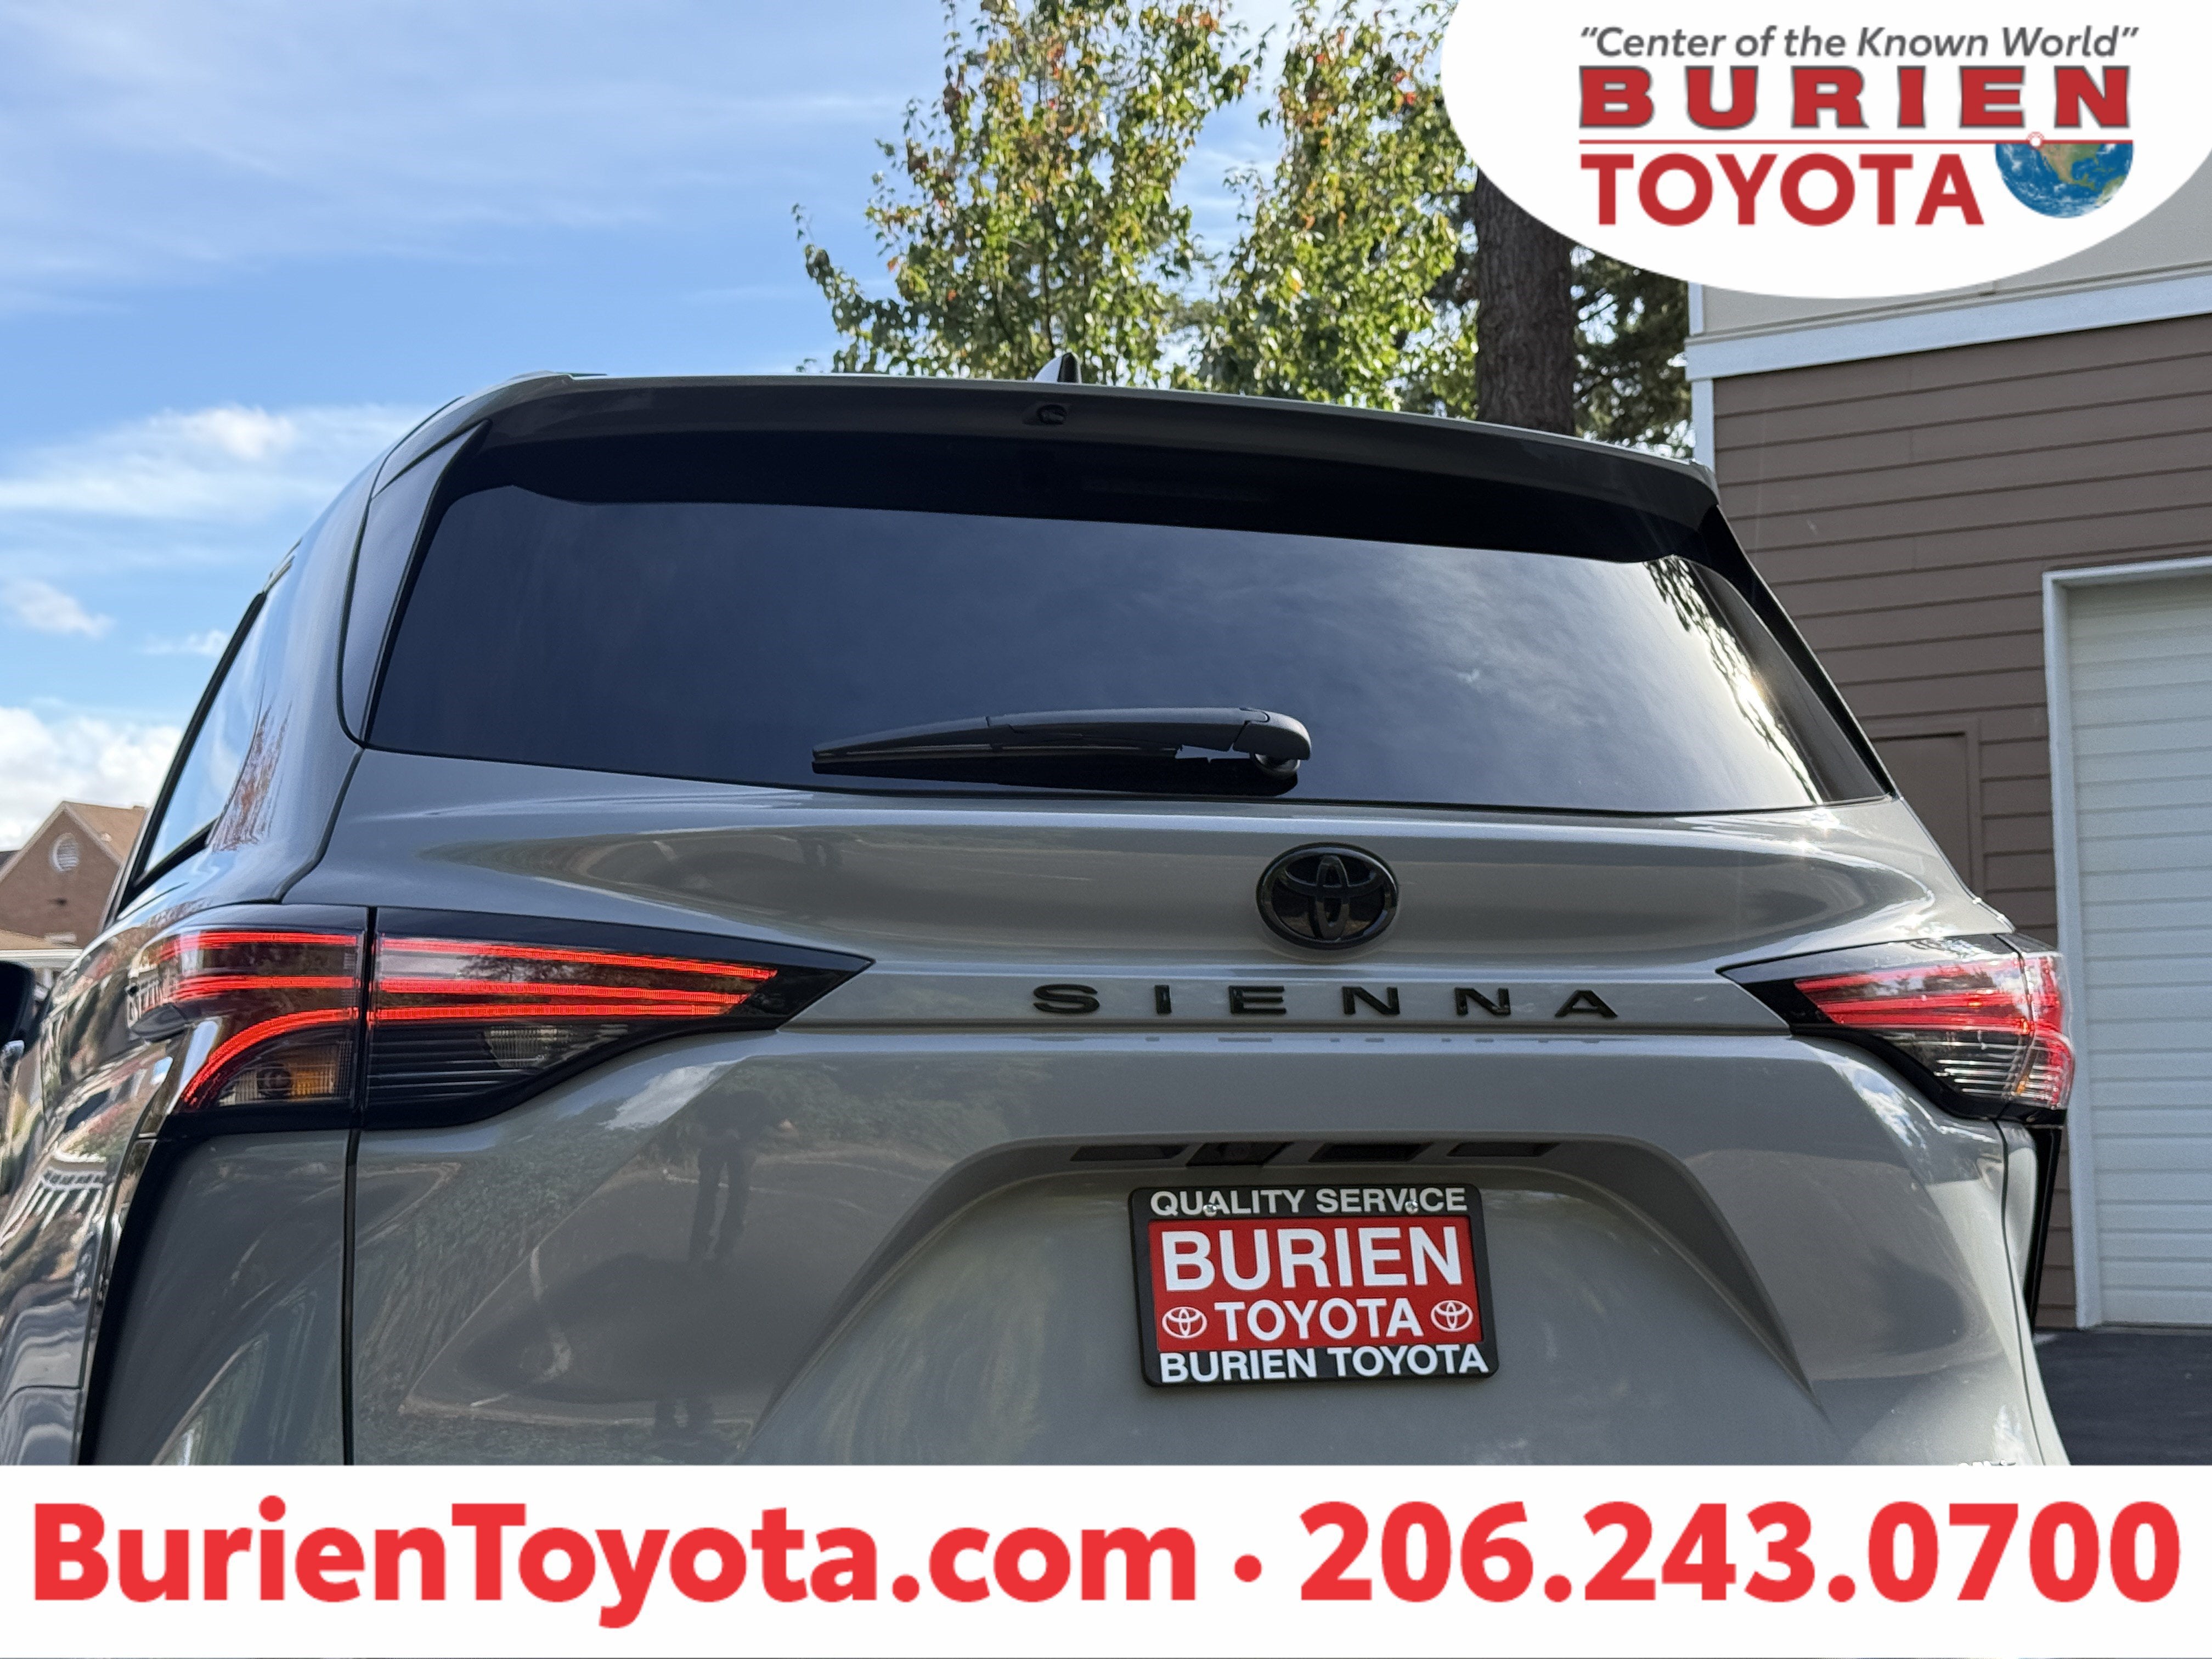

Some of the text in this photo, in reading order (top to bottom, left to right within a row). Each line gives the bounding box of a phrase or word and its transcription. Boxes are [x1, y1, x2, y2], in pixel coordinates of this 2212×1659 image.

[1032, 983, 1619, 1019] SIENNA
[1150, 1187, 1468, 1216] QUALITY SERVICE
[1161, 1226, 1463, 1291] BURIEN
[1214, 1297, 1424, 1341] TOYOTA
[1160, 1343, 1489, 1384] BURIEN TOYOTA
